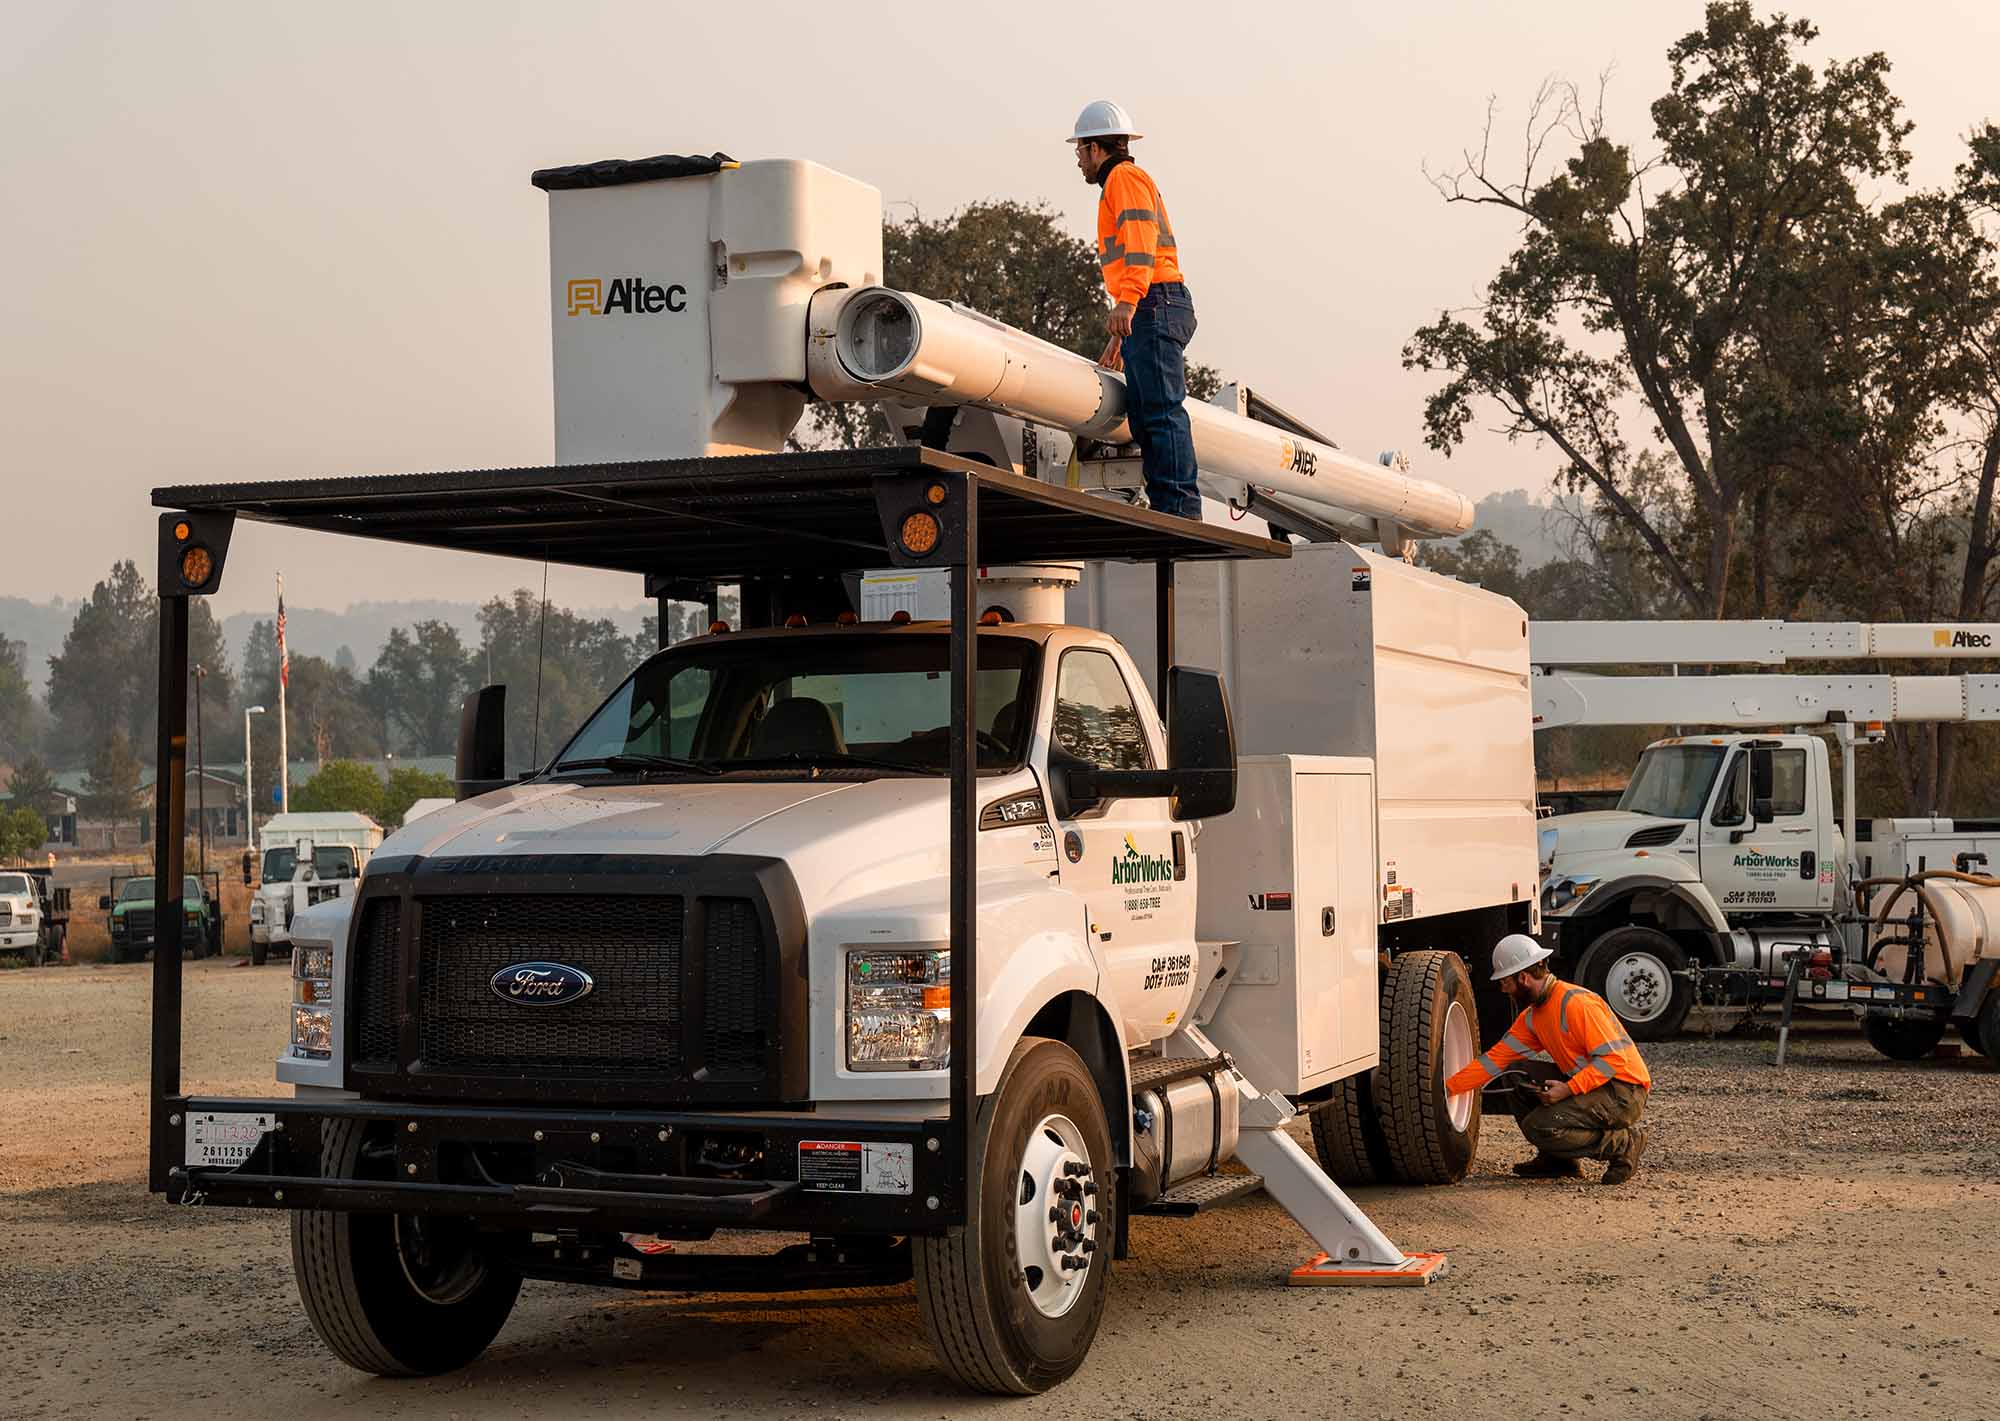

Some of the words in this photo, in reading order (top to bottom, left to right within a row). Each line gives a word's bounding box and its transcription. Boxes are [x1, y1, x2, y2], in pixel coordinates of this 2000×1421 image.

[604, 278, 686, 314] Altec
[1952, 631, 1991, 647] Altec
[1112, 854, 1171, 884] ArborWorks
[1733, 855, 1799, 867] ArborWorks
[1152, 957, 1166, 973] CA#
[1167, 954, 1190, 971] 361649
[510, 969, 565, 995] Ford
[1144, 974, 1163, 990] DOT#
